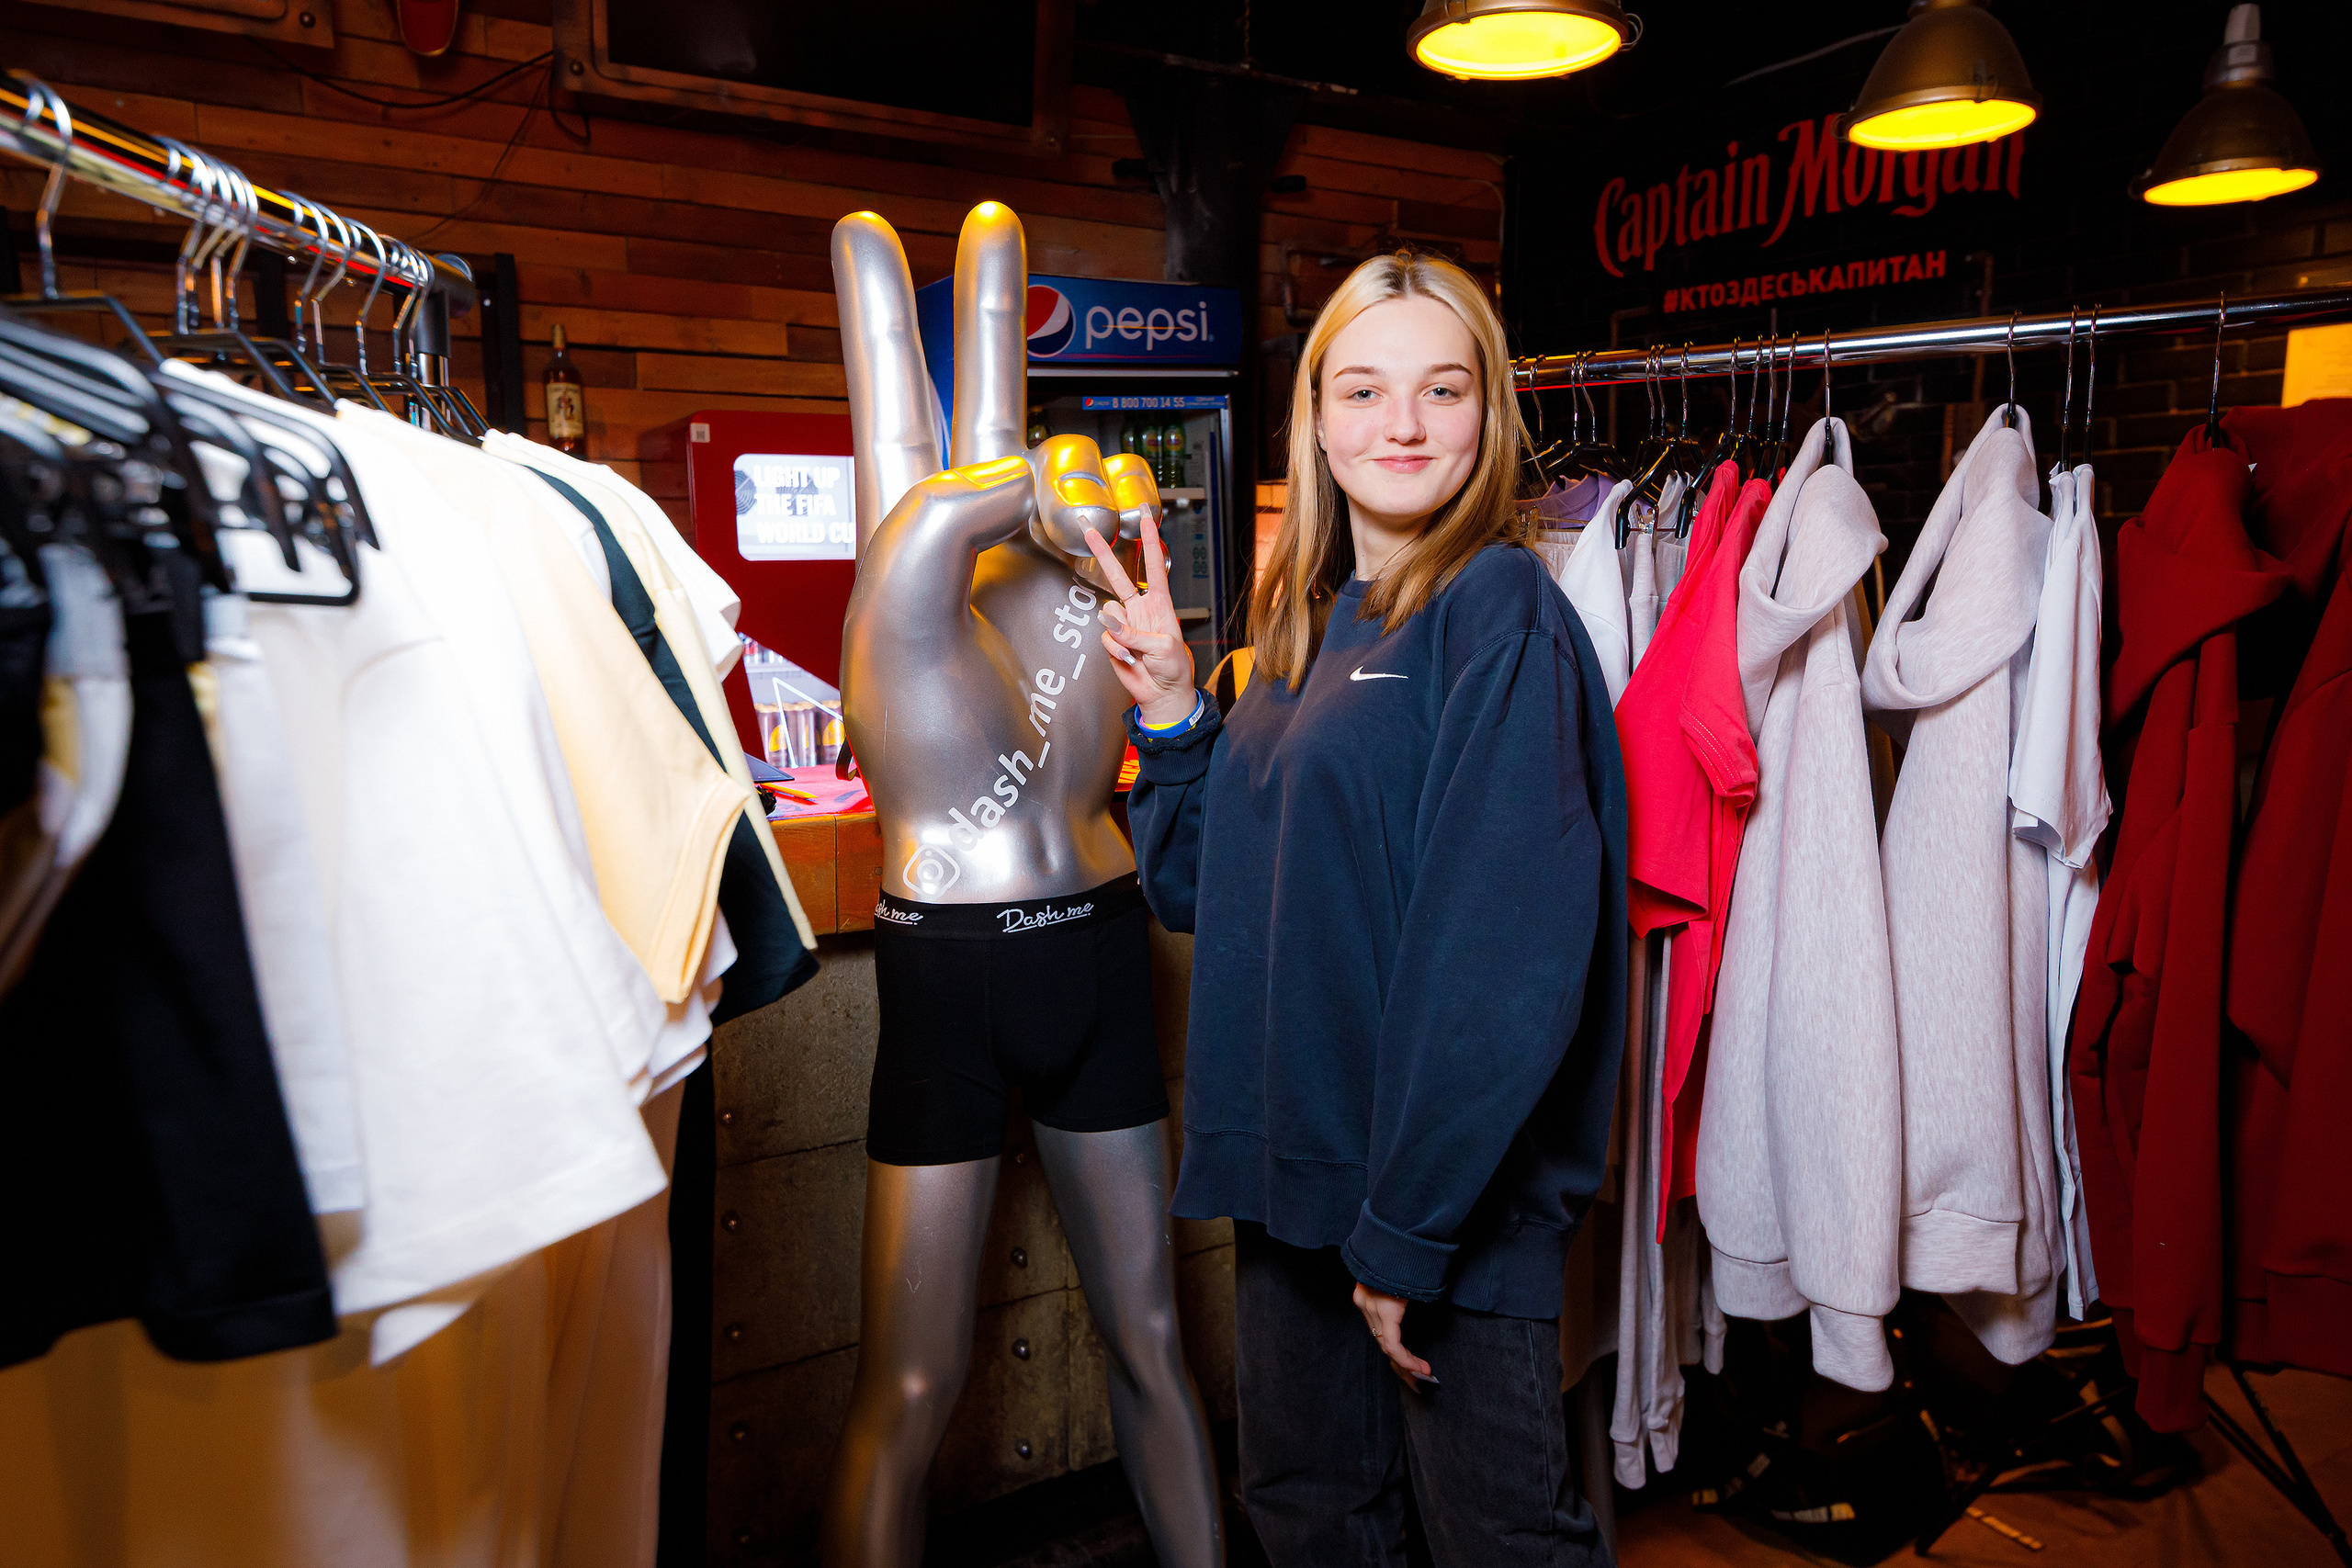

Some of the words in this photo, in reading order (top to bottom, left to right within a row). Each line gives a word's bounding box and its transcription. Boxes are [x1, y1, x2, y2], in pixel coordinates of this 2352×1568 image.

[1594, 140, 1770, 277] Captain
[1663, 249, 1947, 313] #КТОЗДЕСЬКАПИТАН
[1085, 300, 1209, 351] pepsi
[1113, 397, 1119, 409] 8
[1121, 397, 1139, 409] 800
[1141, 397, 1159, 408] 700
[1160, 397, 1171, 408] 14
[1173, 397, 1185, 408] 55
[752, 465, 810, 488] LIGHT
[812, 467, 841, 489] UP
[753, 492, 793, 516] THE
[795, 493, 837, 516] FIFA
[755, 521, 825, 544] WORLD
[829, 522, 855, 544] CU
[891, 908, 924, 921] me
[996, 905, 1065, 932] Dash
[1067, 902, 1094, 918] me
